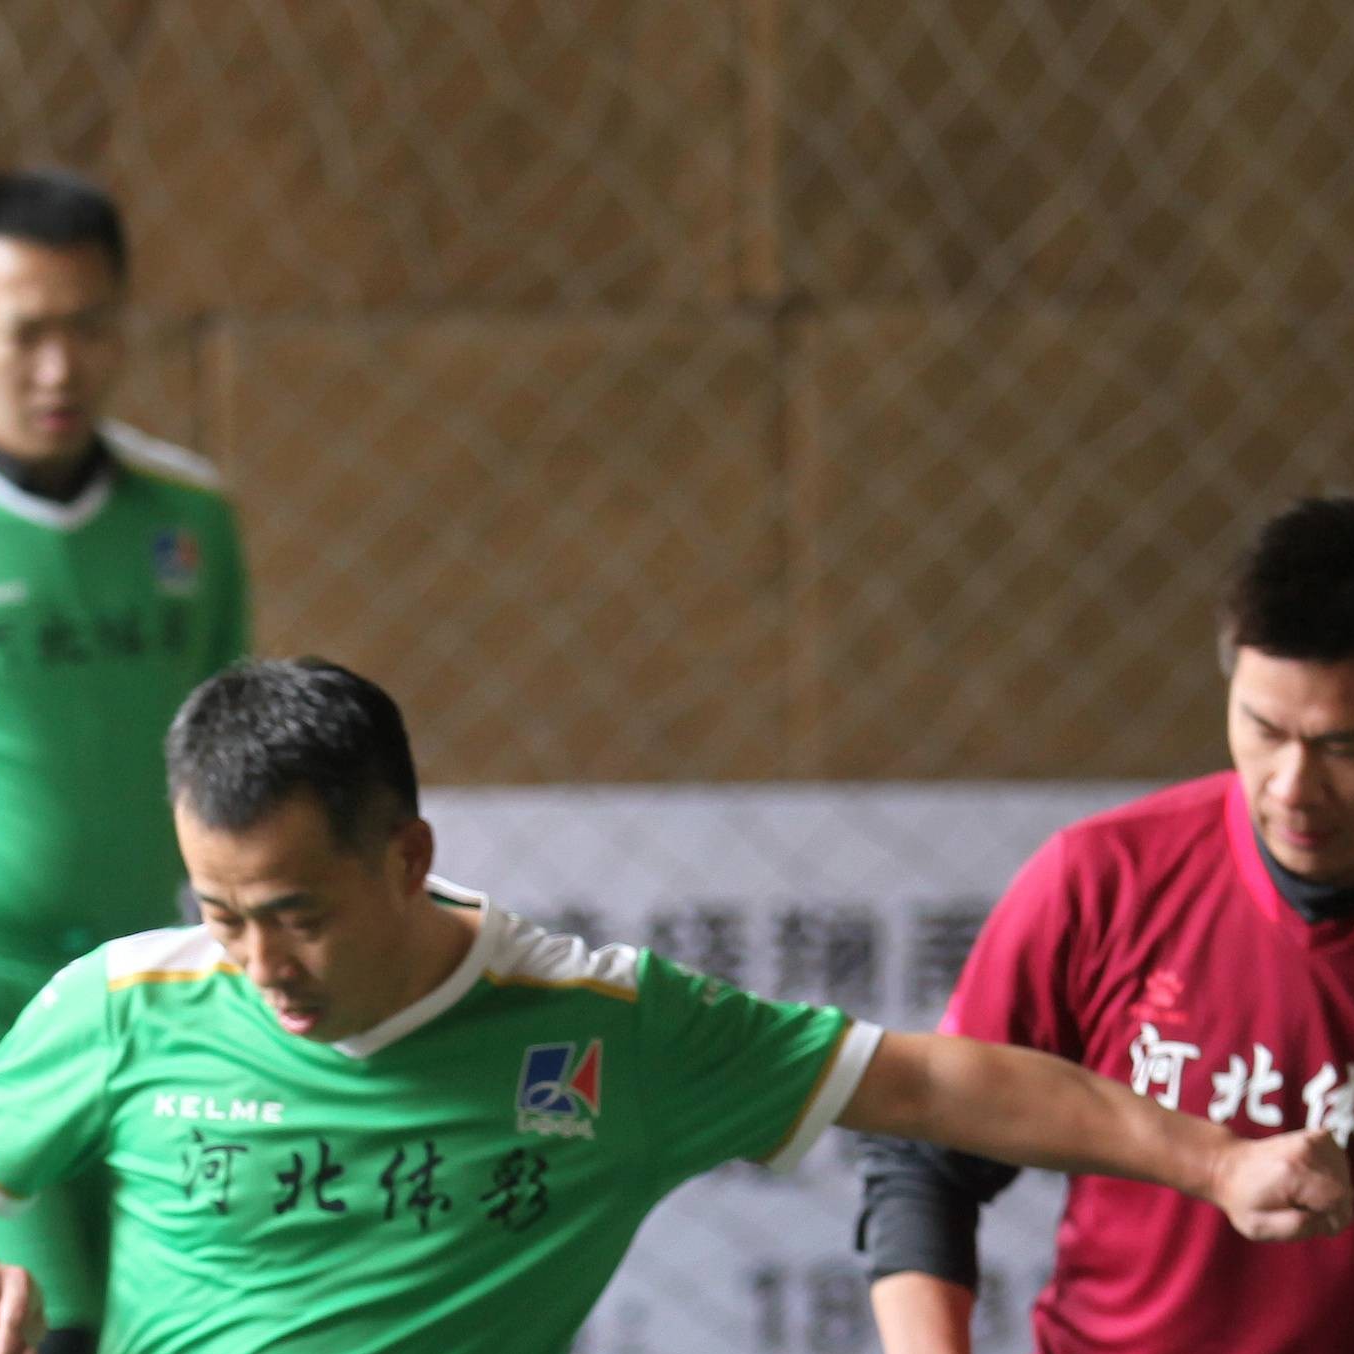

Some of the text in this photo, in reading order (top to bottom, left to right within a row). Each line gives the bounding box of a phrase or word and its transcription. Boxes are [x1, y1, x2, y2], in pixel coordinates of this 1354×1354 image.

[153, 1093, 285, 1124] KELME
[181, 1126, 550, 1233] 河北体彩
